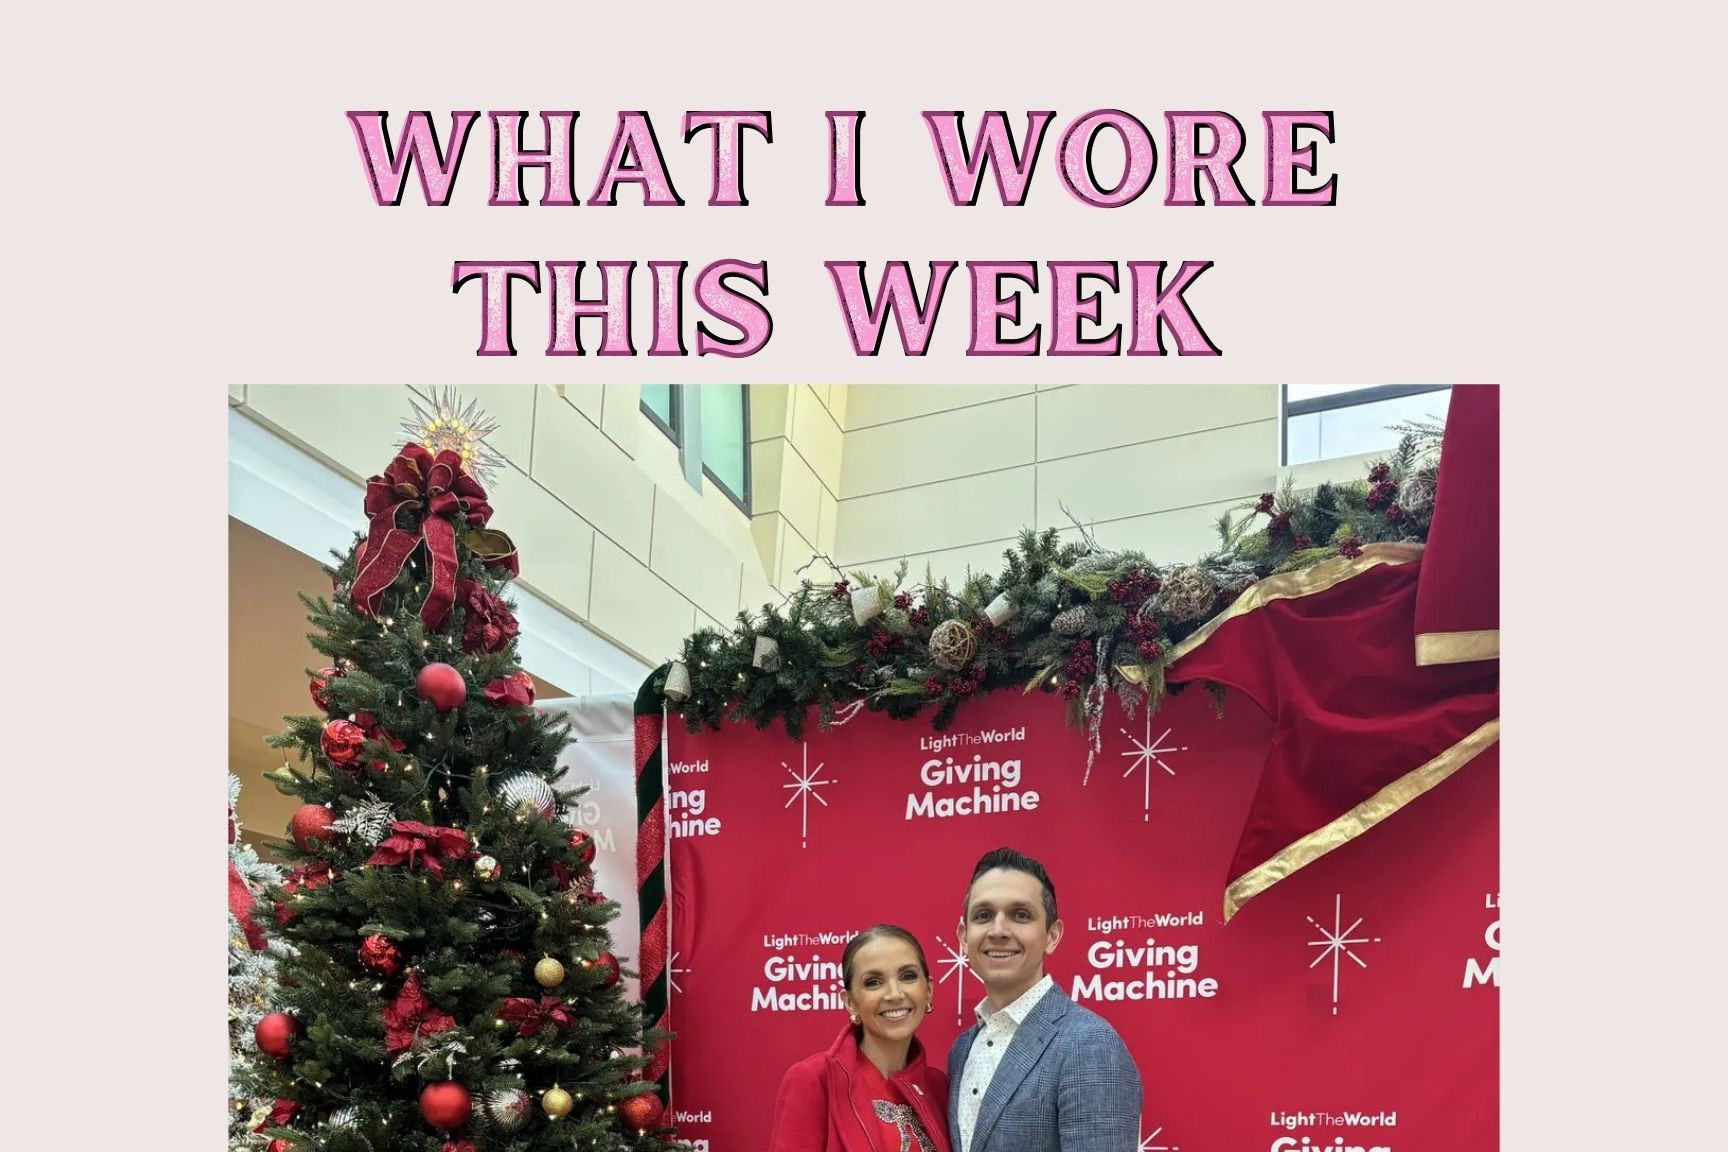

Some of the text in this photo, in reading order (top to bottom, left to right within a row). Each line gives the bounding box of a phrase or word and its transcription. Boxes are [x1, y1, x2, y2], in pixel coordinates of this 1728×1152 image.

[920, 727, 1025, 752] LightTheWorld
[920, 754, 1021, 787] Giving
[905, 787, 1040, 820] Machine
[1088, 911, 1204, 935] LightTheWorld
[764, 954, 844, 987] Givin
[1087, 938, 1198, 973] Giving
[1071, 970, 1219, 1001] Machine
[1270, 1111, 1397, 1130] LightTheWorld
